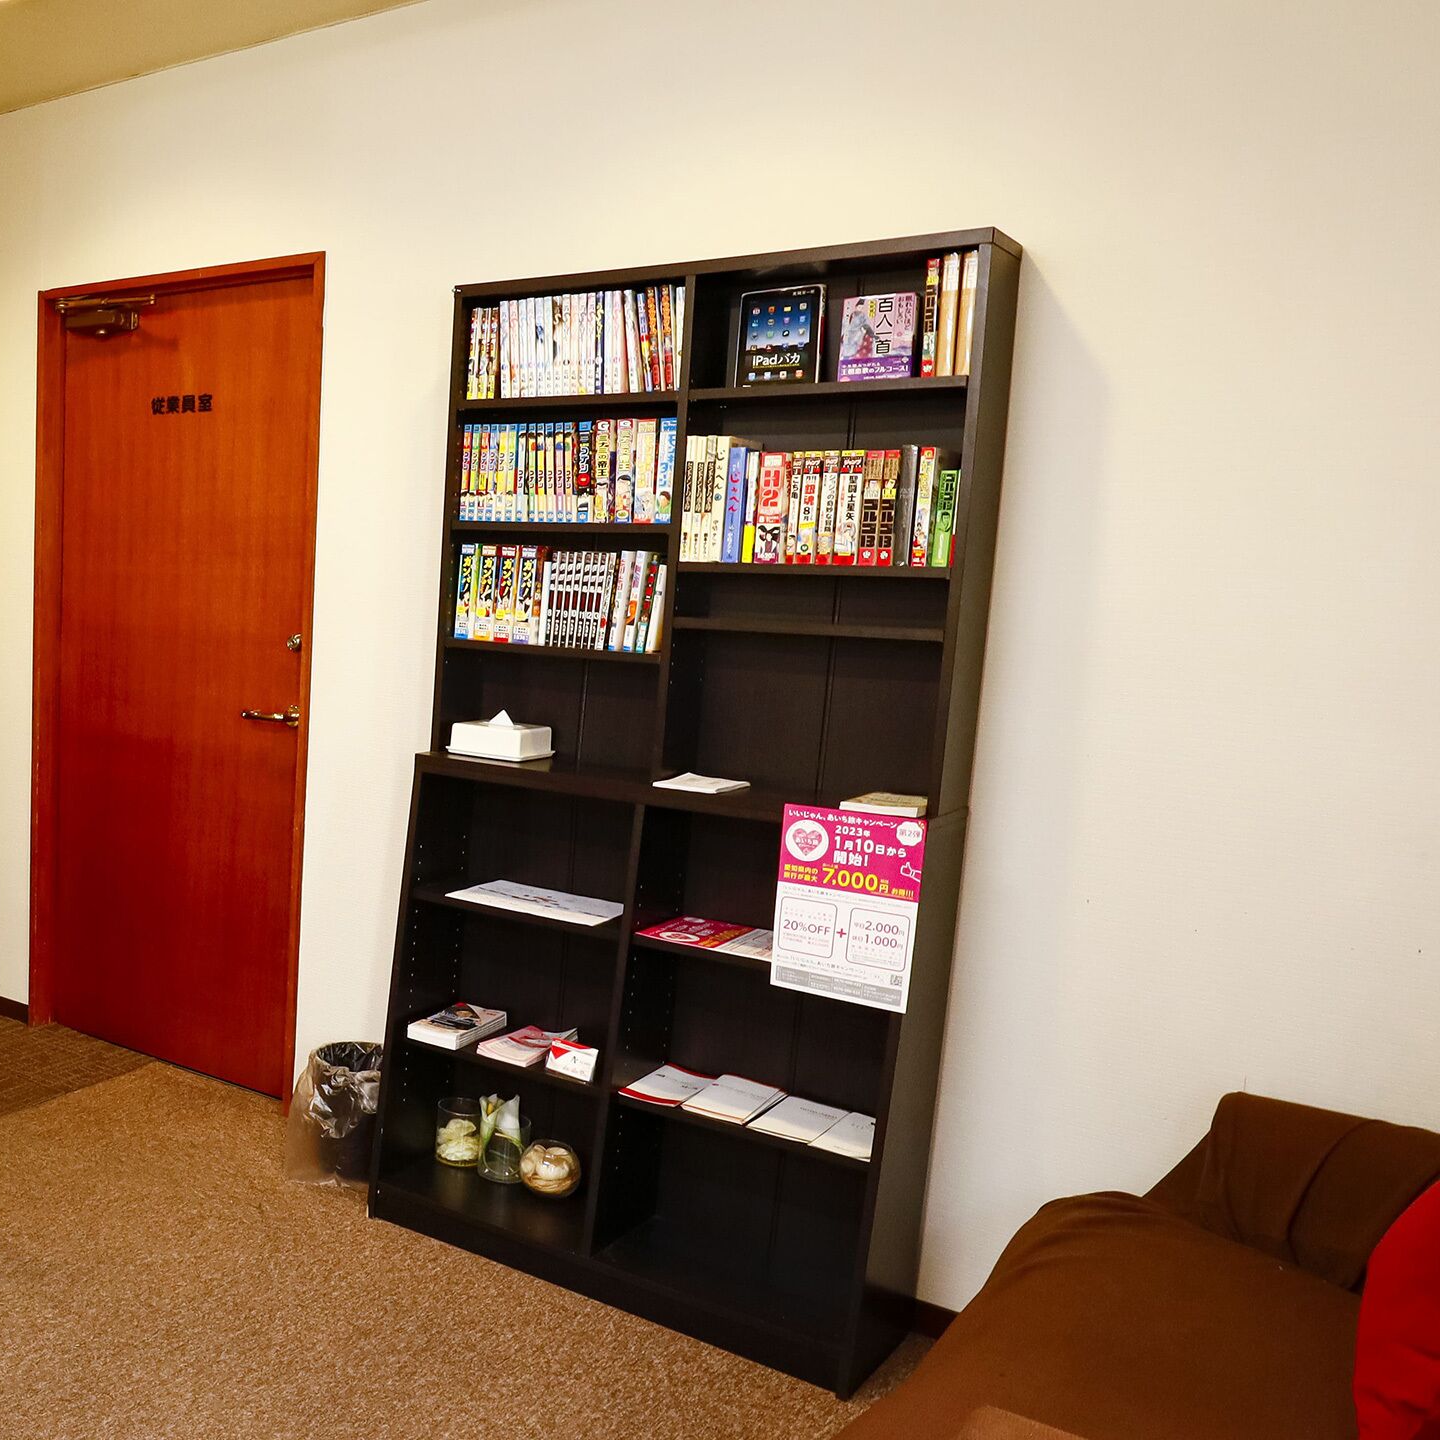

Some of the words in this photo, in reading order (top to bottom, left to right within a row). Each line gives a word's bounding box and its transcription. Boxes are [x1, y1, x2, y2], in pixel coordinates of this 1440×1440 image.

[875, 297, 895, 355] 百人一首
[752, 352, 800, 366] iPadバカ
[151, 393, 213, 415] 従業員室
[579, 447, 589, 474] コナン
[597, 434, 609, 477] ミナミの帝王
[762, 469, 781, 508] H2
[845, 475, 859, 521] 聖闘士星矢
[834, 825, 871, 837] 2023年
[834, 835, 907, 858] 1月10日から
[833, 850, 869, 867] 開始!
[783, 919, 832, 936] 20%OFF
